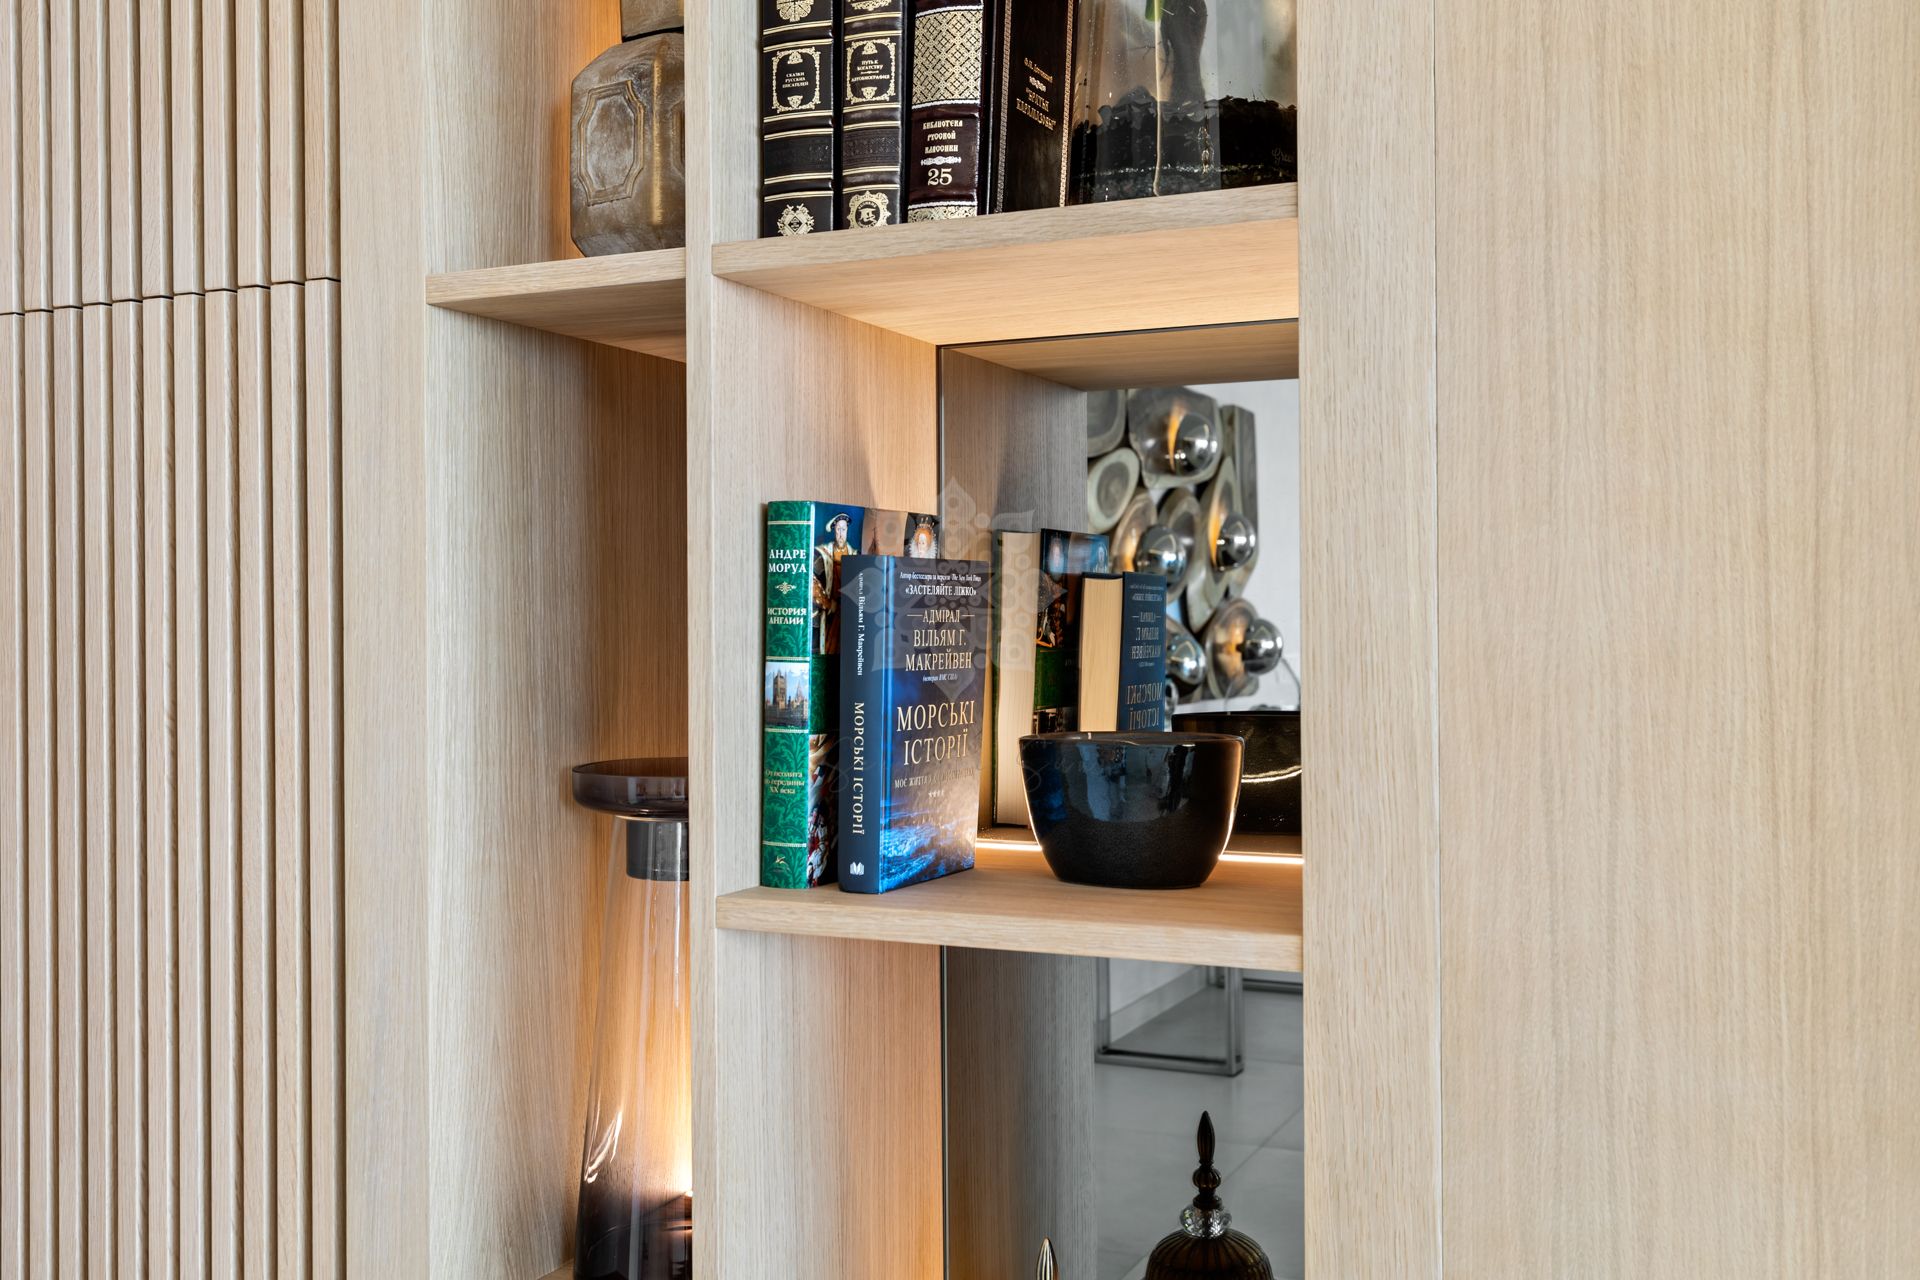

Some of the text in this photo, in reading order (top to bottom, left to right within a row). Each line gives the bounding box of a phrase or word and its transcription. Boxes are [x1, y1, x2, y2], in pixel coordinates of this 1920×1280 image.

[922, 119, 963, 130] БИБЛИОТЕКА
[927, 130, 956, 141] РУССКОЙ
[924, 144, 959, 154] КЛАССИКИ
[927, 168, 953, 186] 25
[769, 549, 807, 560] АНДРЕ
[768, 562, 807, 575] МОРУА
[905, 583, 977, 596] «ЗАСТЕЛЯЙТЕ ЛІЖКО»
[767, 607, 807, 616] ИСТОРИЯ
[922, 609, 960, 624] АДМІРАЛ
[769, 616, 804, 625] АНГЛИИ
[913, 629, 967, 647] ВІЛЬЯМ Г.
[856, 633, 865, 676] Макрейвен
[905, 648, 972, 671] МАКРЕЙВЕН
[896, 700, 975, 732] МОРСЬКІ
[903, 728, 968, 766] ІСТОРІЇ
[852, 702, 865, 835] МОРСЬКІ ІСТОРІЇ
